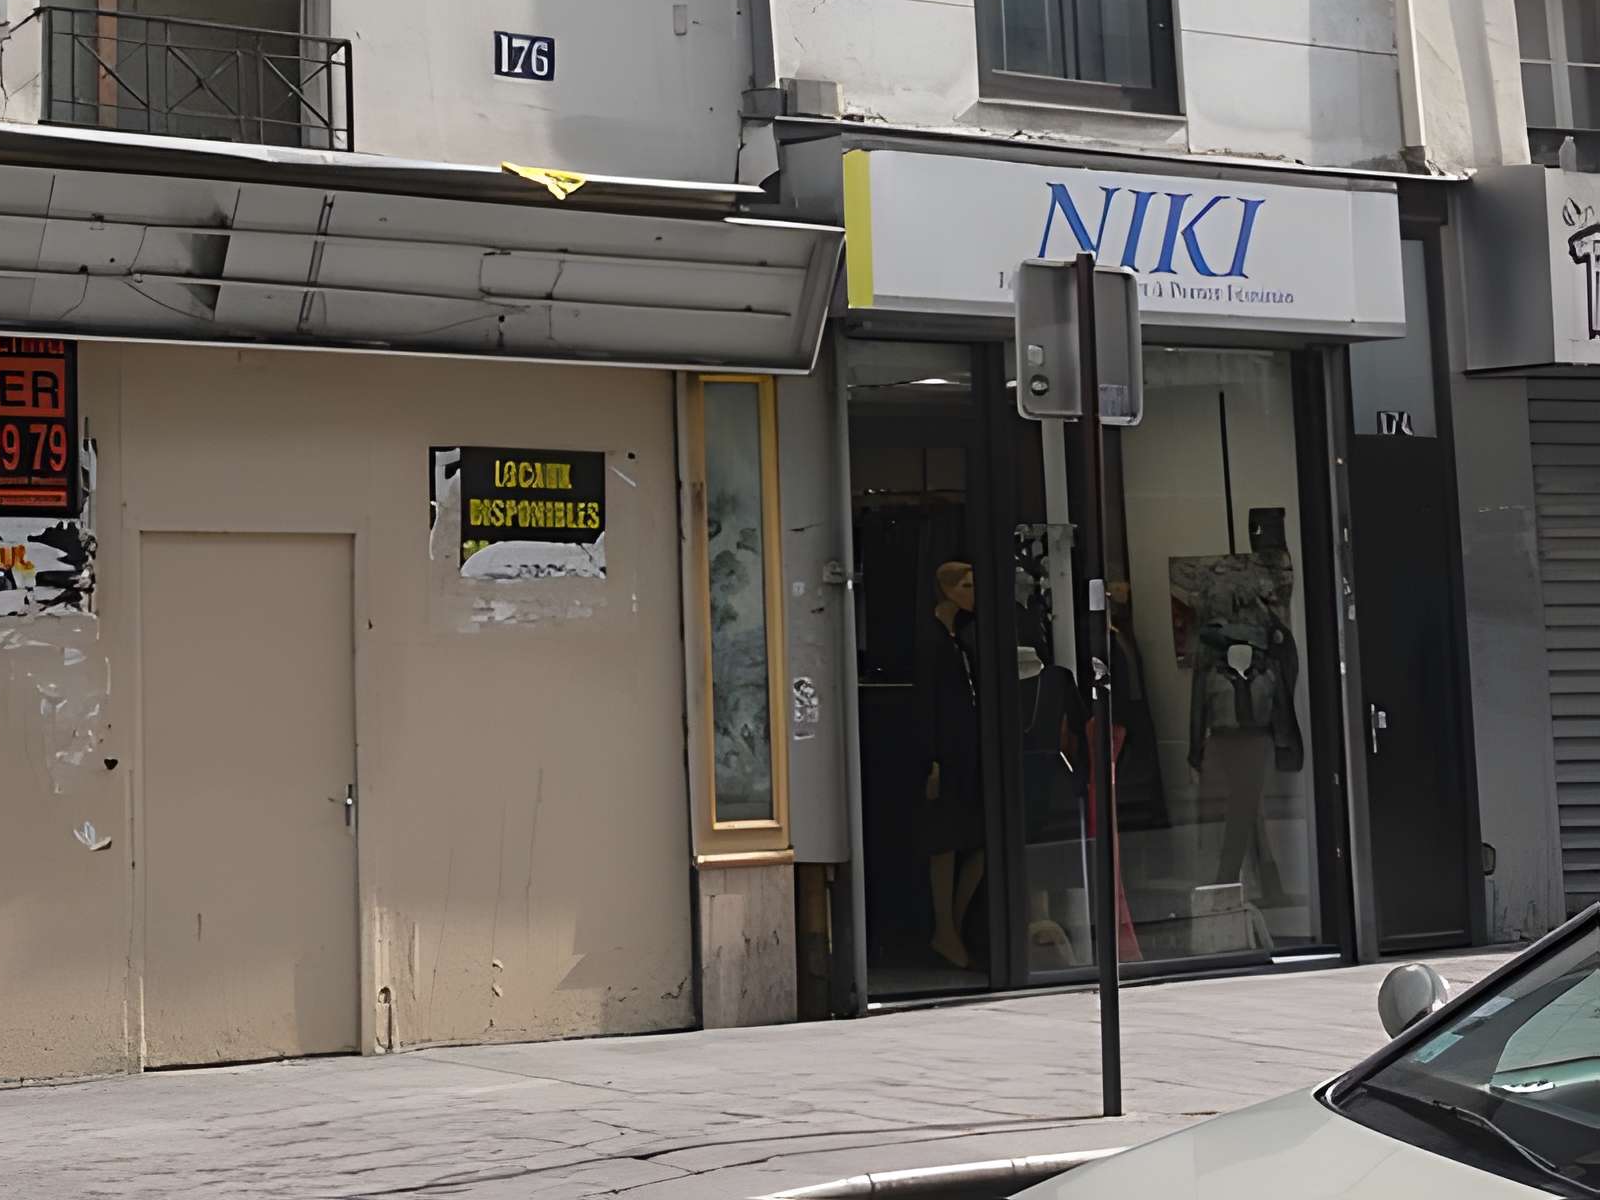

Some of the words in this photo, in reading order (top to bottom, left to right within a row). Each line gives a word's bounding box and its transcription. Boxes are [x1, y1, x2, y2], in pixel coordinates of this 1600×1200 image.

[500, 34, 548, 76] 176
[1037, 182, 1266, 279] NIKI
[29, 423, 69, 472] 79
[469, 498, 600, 529] DISPONIBLES
